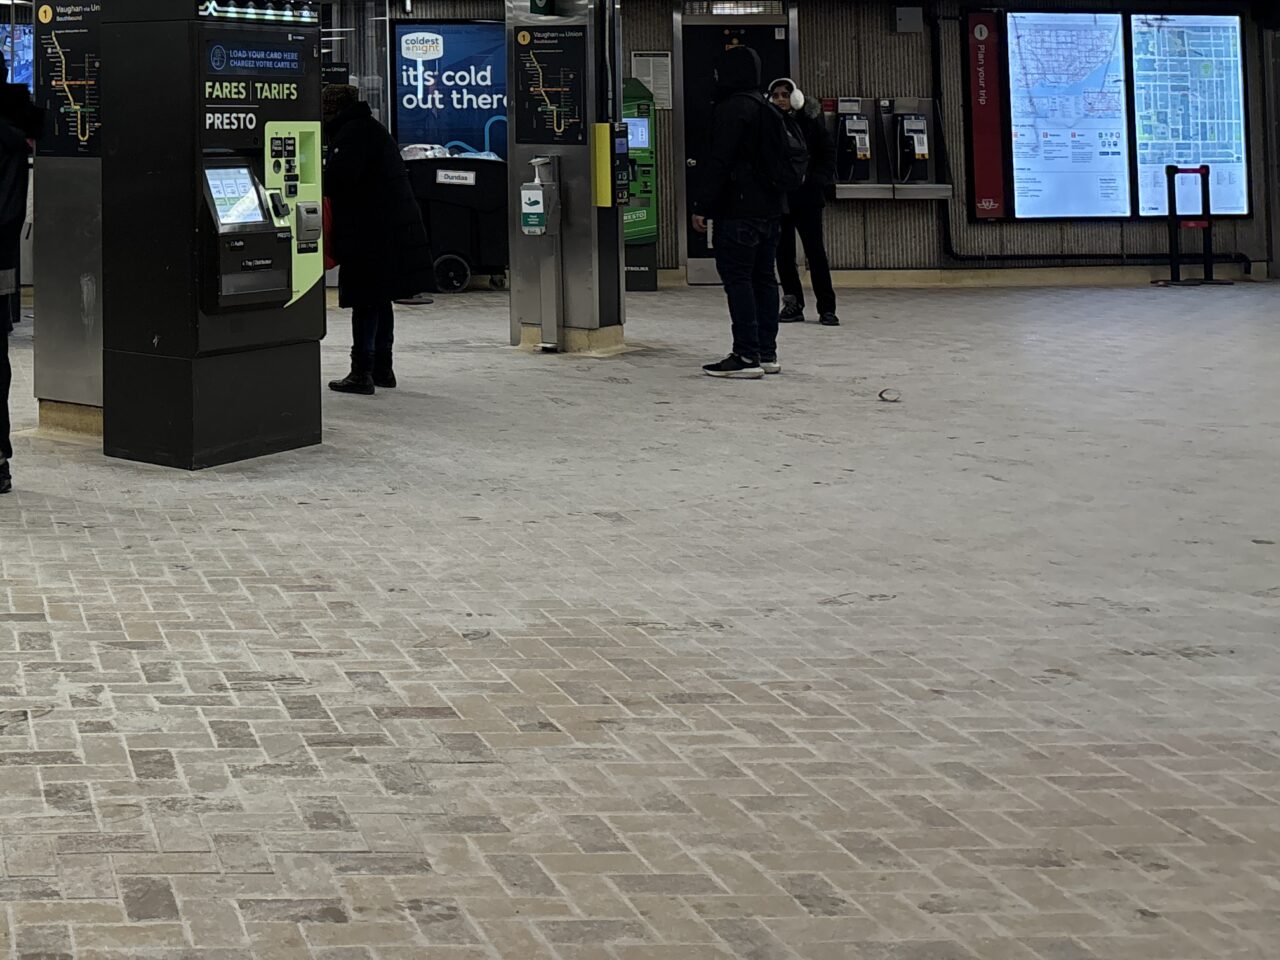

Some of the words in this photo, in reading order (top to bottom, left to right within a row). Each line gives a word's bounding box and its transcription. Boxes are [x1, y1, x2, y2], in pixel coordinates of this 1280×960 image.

[55, 5, 83, 15] Vaughan
[90, 3, 101, 12] Un
[404, 36, 440, 46] coldest
[533, 31, 559, 39] Vaughan
[229, 49, 247, 58] LOAD
[248, 50, 265, 59] YOUR
[266, 51, 282, 59] CARD
[283, 51, 298, 60] HERE
[411, 44, 440, 55] night
[977, 44, 986, 65] Plan
[229, 60, 255, 68] CHARGEZ
[273, 61, 291, 69] CARTE
[402, 65, 435, 86] it's
[441, 65, 492, 86] cold
[977, 66, 986, 88] your
[205, 81, 246, 99] FARES
[255, 82, 298, 100] TARIFS
[402, 90, 444, 109] out
[978, 89, 986, 105] trip
[205, 112, 257, 130] PRESTO
[444, 173, 468, 181] Dundas
[623, 212, 645, 222] RESTO
